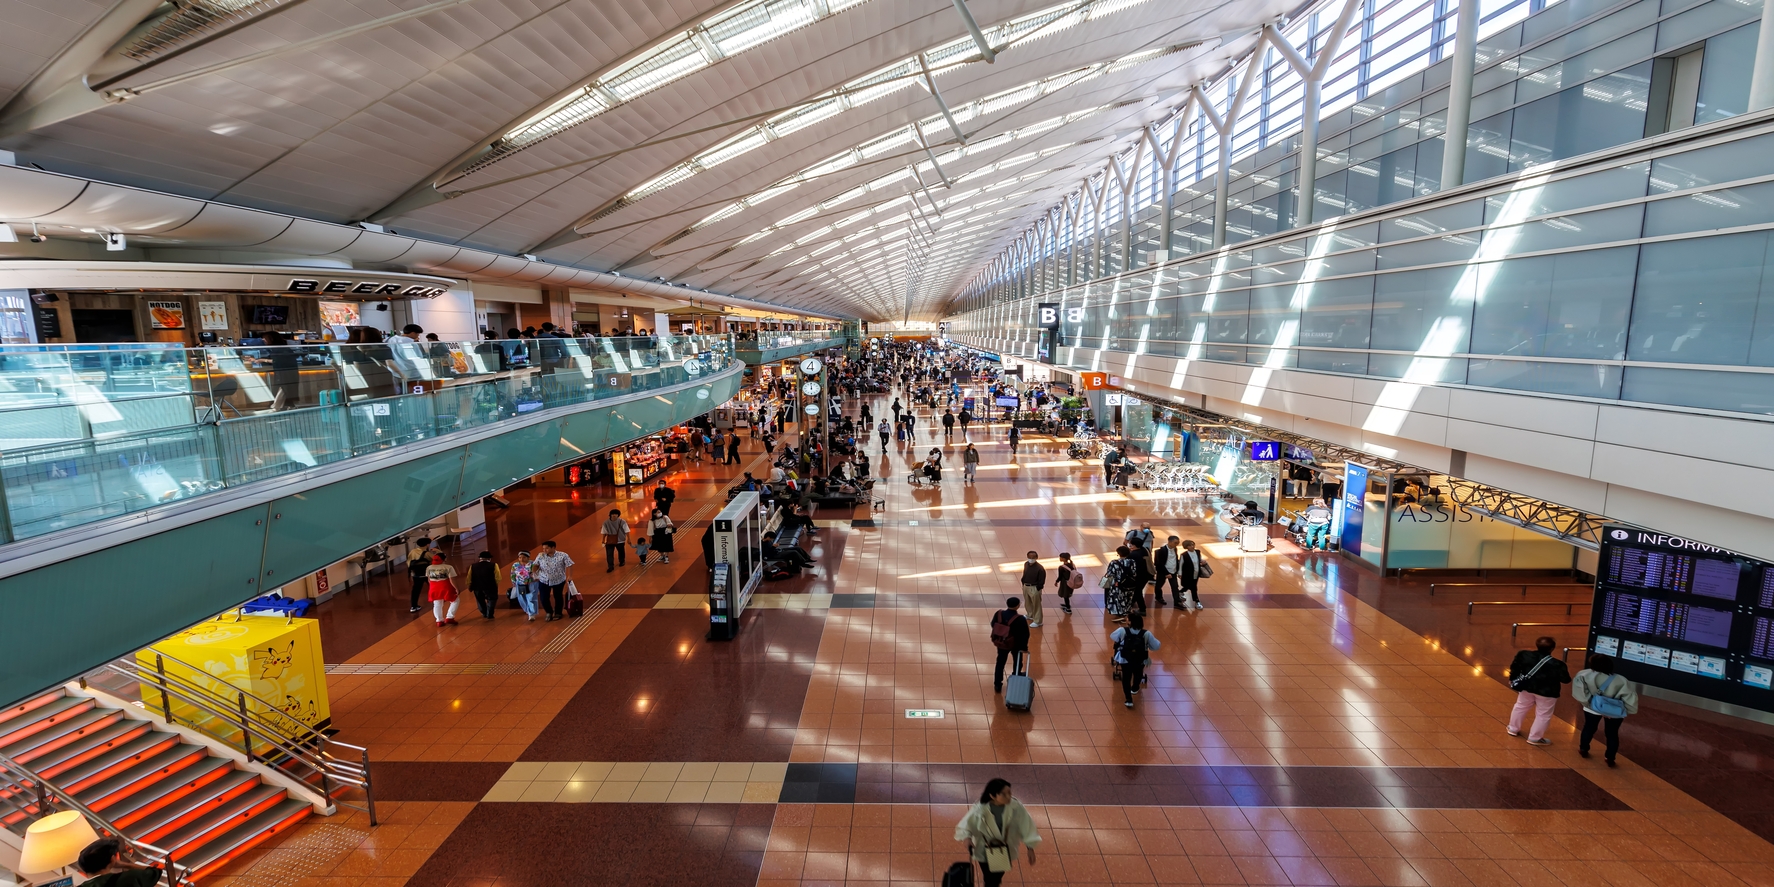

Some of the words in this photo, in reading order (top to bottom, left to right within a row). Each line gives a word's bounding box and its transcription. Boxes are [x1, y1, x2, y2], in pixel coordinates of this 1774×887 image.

[287, 278, 401, 295] BEER
[1041, 307, 1056, 323] B
[806, 361, 814, 371] 4
[1093, 376, 1102, 386] B
[721, 535, 729, 564] Informat
[1637, 532, 1738, 556] INFORM
